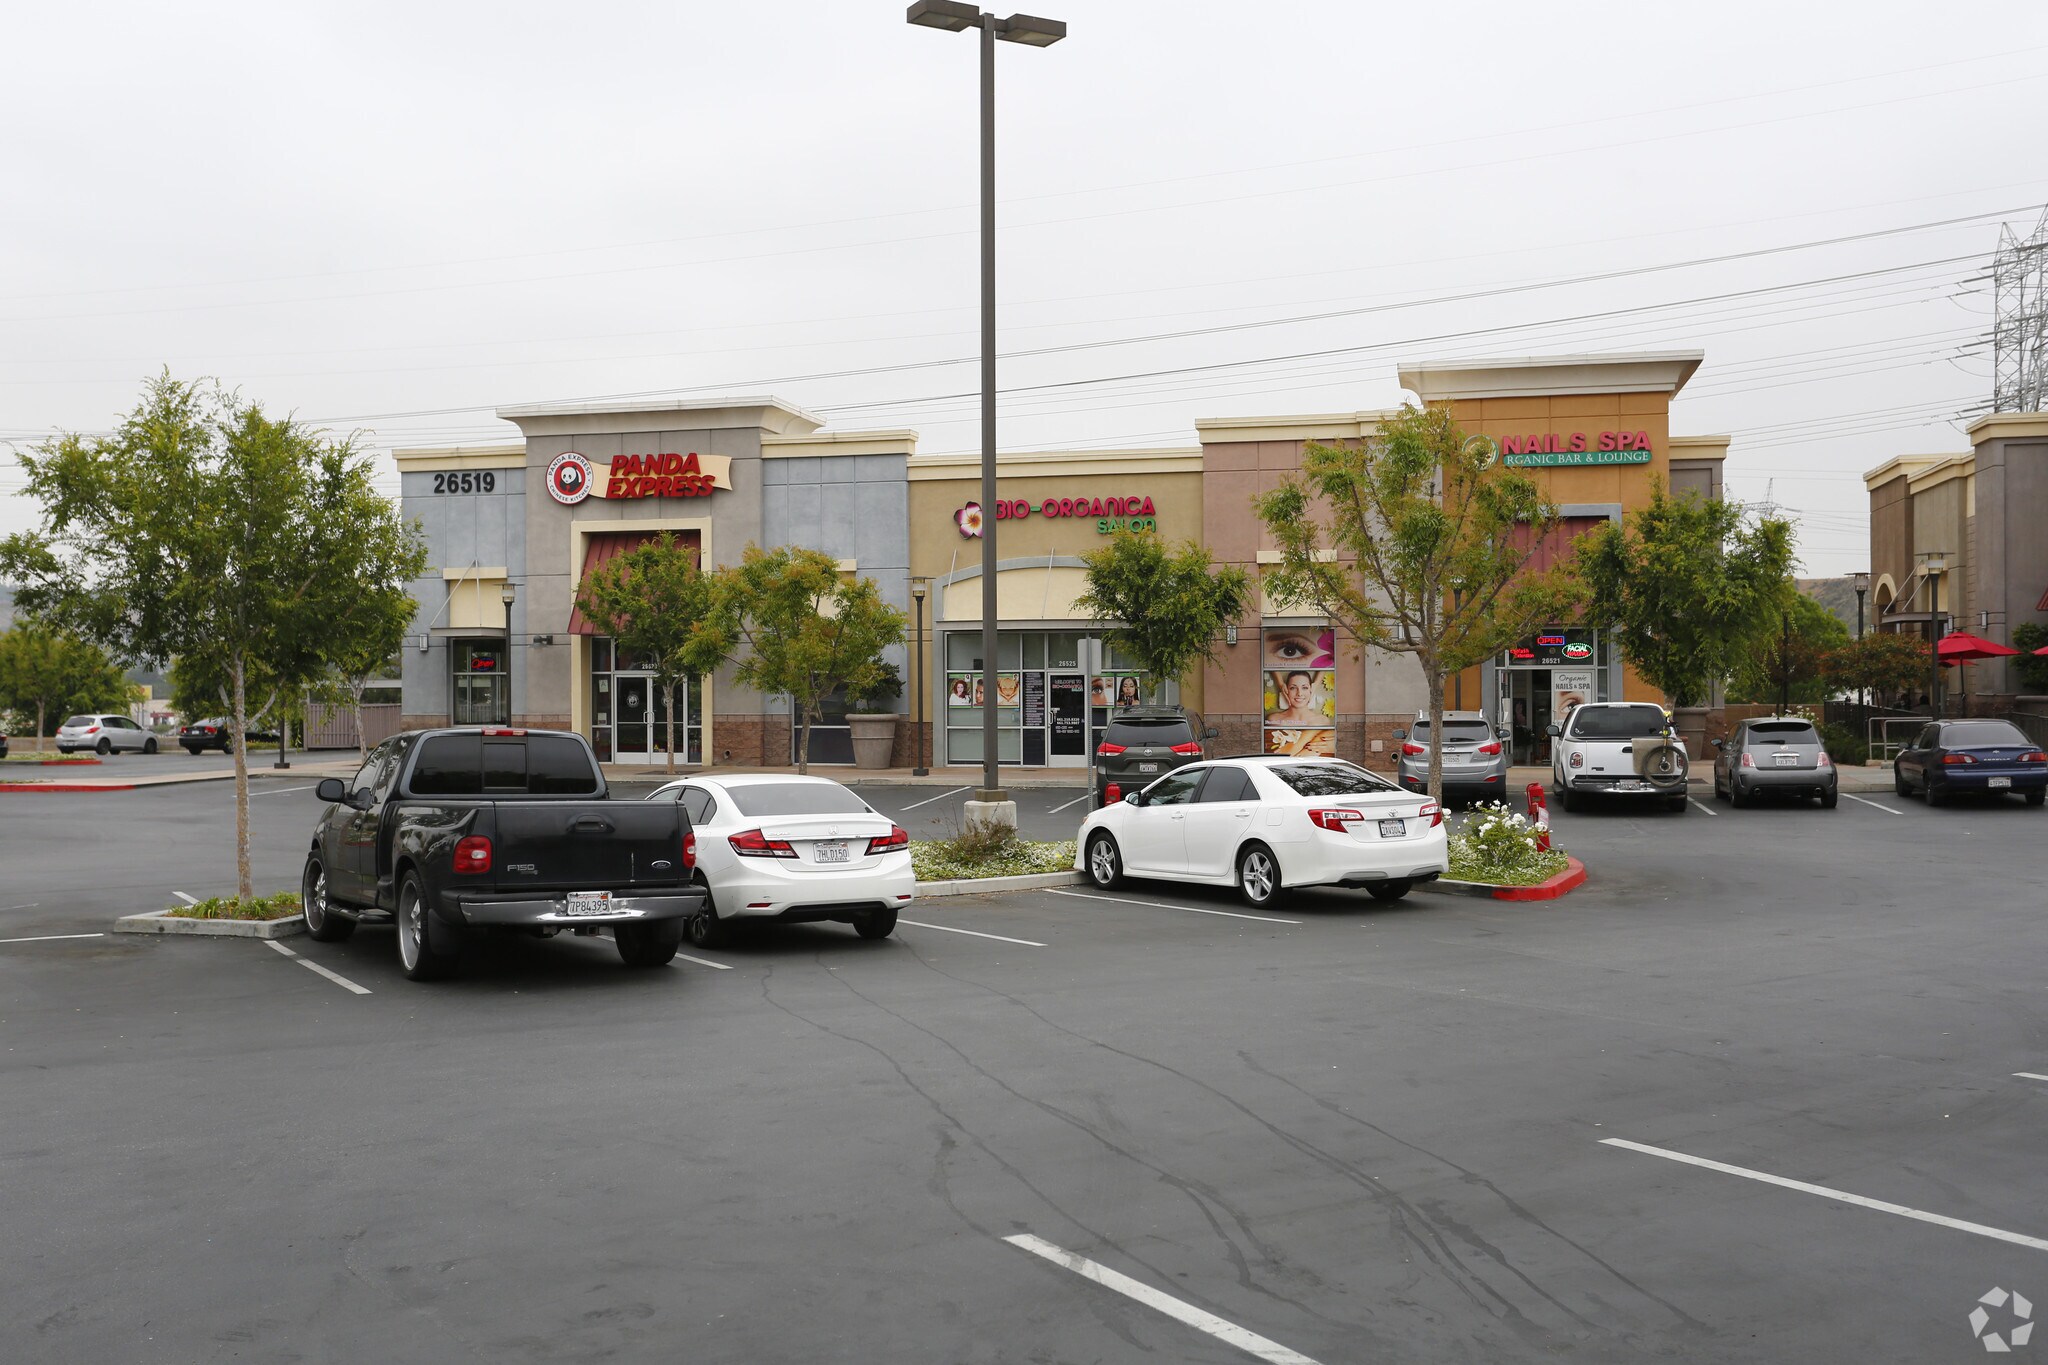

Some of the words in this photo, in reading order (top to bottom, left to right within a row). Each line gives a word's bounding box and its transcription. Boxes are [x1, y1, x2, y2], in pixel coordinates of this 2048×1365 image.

[1503, 432, 1587, 455] NAILS
[1599, 431, 1651, 452] SPA
[548, 456, 566, 476] PANDA
[567, 454, 592, 476] EXPRESS
[610, 453, 701, 477] PANDA
[1558, 453, 1581, 464] BAR
[1586, 452, 1593, 463] &
[1598, 451, 1649, 463] LOUNGE
[433, 471, 496, 494] 26519
[549, 484, 568, 502] CHINESE
[570, 484, 590, 502] KITCHEN
[605, 475, 716, 499] EXPRESS
[996, 496, 1156, 519] BIO-ORGANICA
[1559, 674, 1587, 683] Organic
[570, 900, 608, 912] 7P84395
